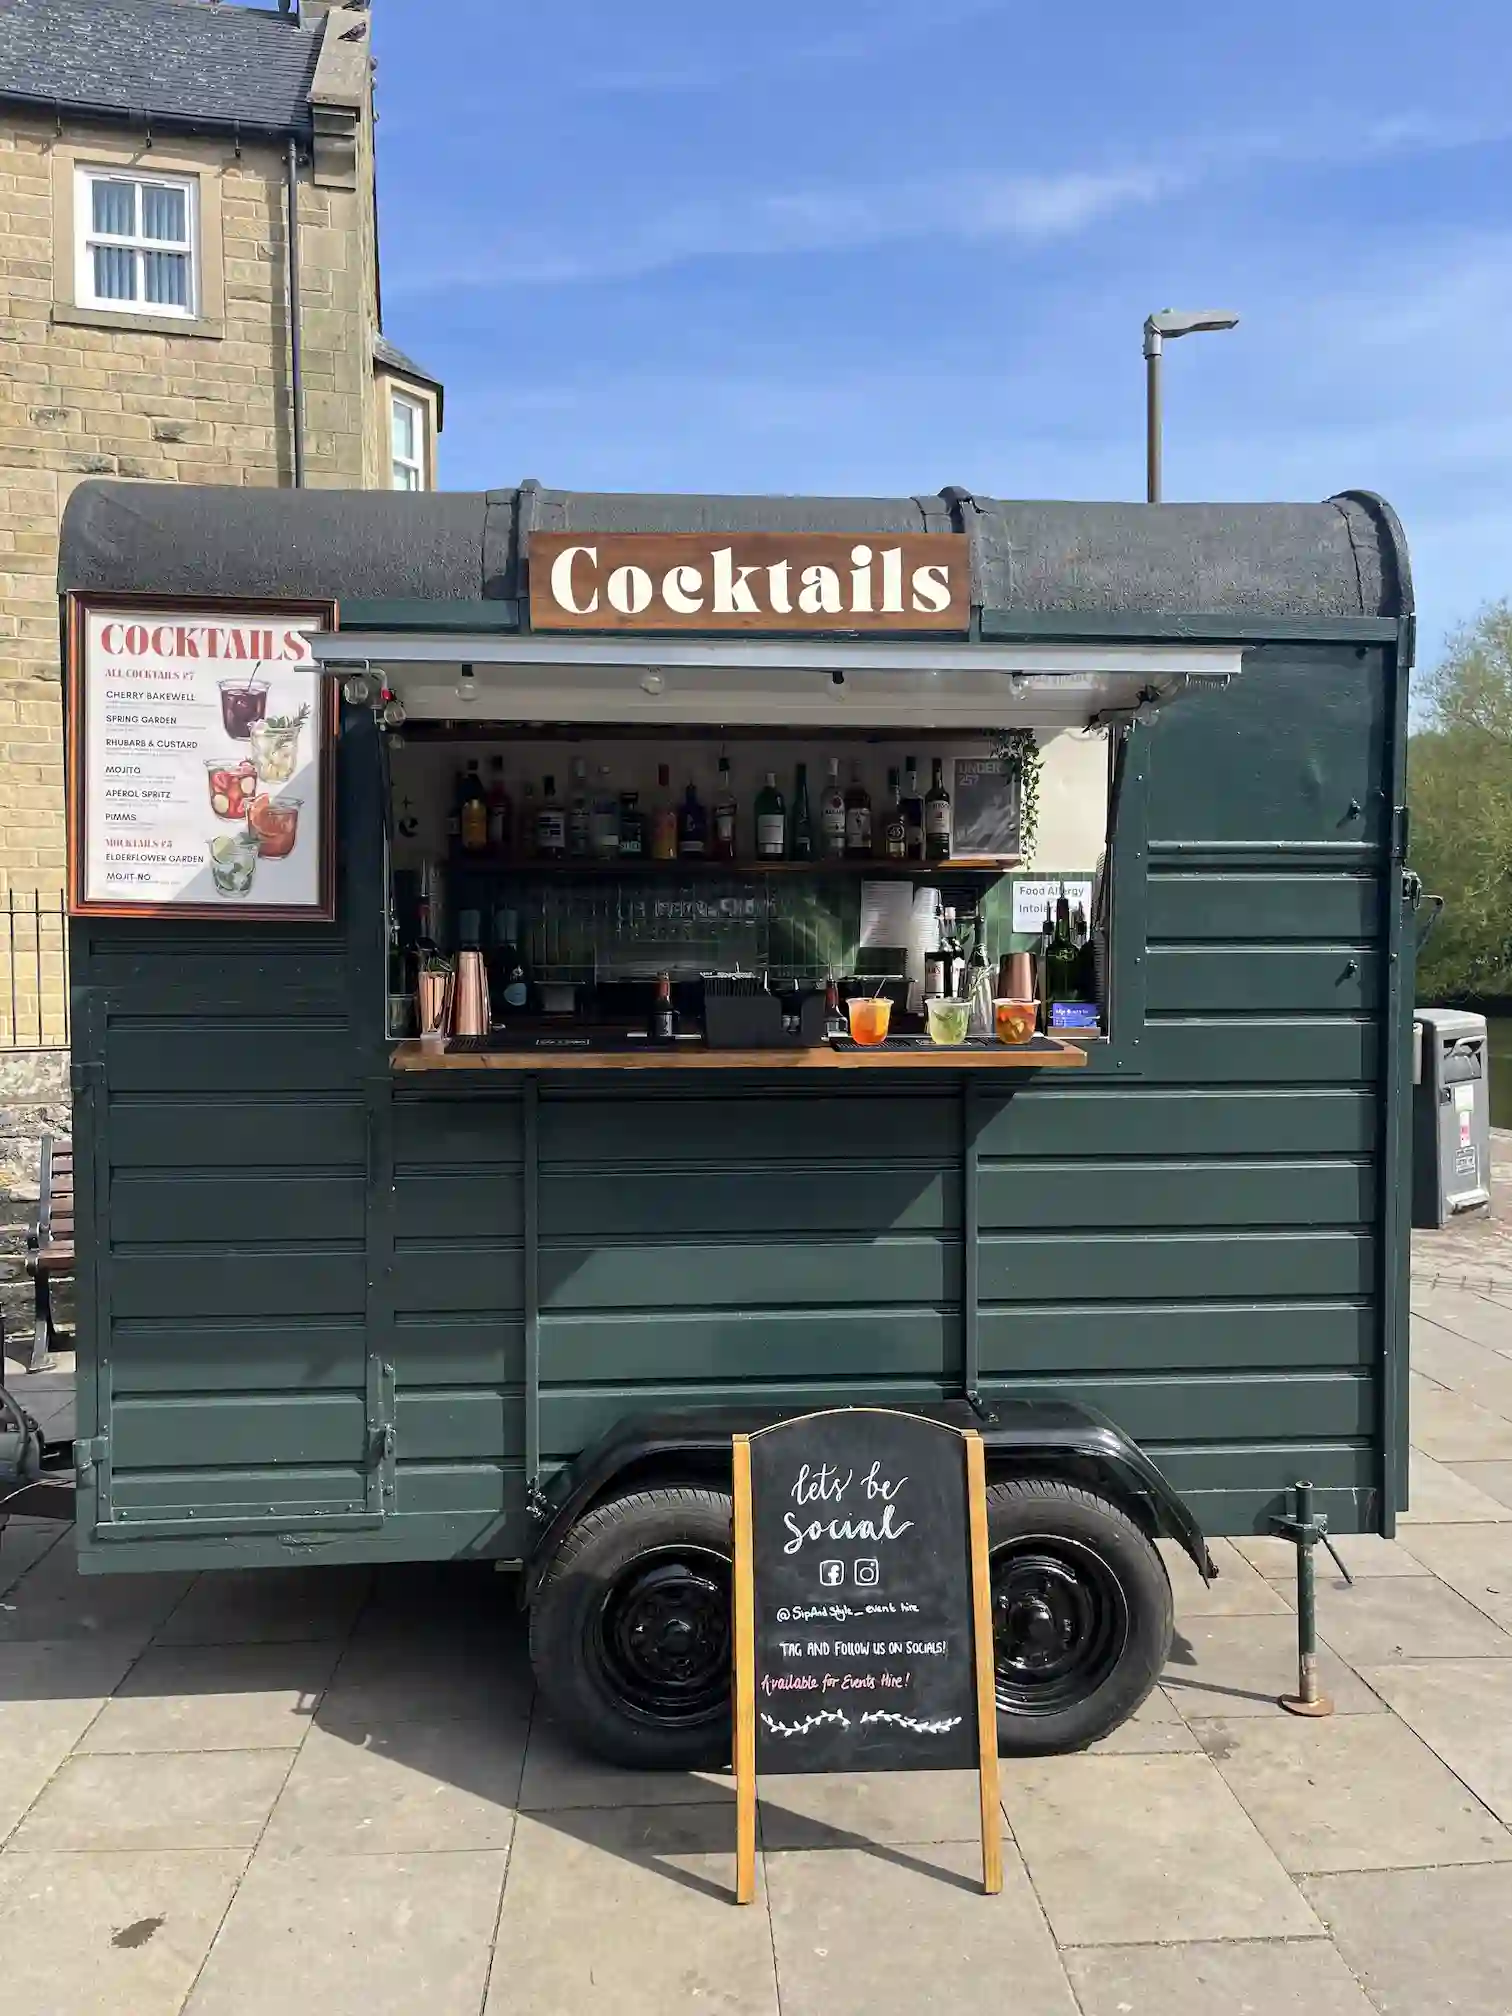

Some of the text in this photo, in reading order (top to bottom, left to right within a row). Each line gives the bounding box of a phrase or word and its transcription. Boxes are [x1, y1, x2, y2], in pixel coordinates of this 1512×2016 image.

[550, 544, 952, 614] Cocktails
[101, 623, 305, 661] COCKTAILS
[105, 668, 123, 678] ALL
[125, 668, 180, 680] COCKTAILS
[106, 690, 196, 701] CHERRY BAKEWELL
[106, 714, 177, 725] SPRING GARDEN
[105, 738, 198, 749] RHUBARB & CUSTARD
[105, 766, 141, 774] MOJITO
[105, 789, 171, 799] APEROL SPRITZ
[105, 812, 137, 821] PIMMS
[105, 838, 159, 849] MOCKTAILS
[105, 853, 204, 863] ELDERFLOWER GARDEN
[1019, 886, 1045, 896] Food
[860, 1460, 909, 1500] be
[779, 1642, 802, 1657] TAG
[807, 1641, 830, 1656] AND
[872, 1642, 886, 1655] US
[888, 1641, 903, 1655] ON
[760, 1673, 819, 1696] Available
[821, 1672, 840, 1694] for
[840, 1673, 876, 1690] Events
